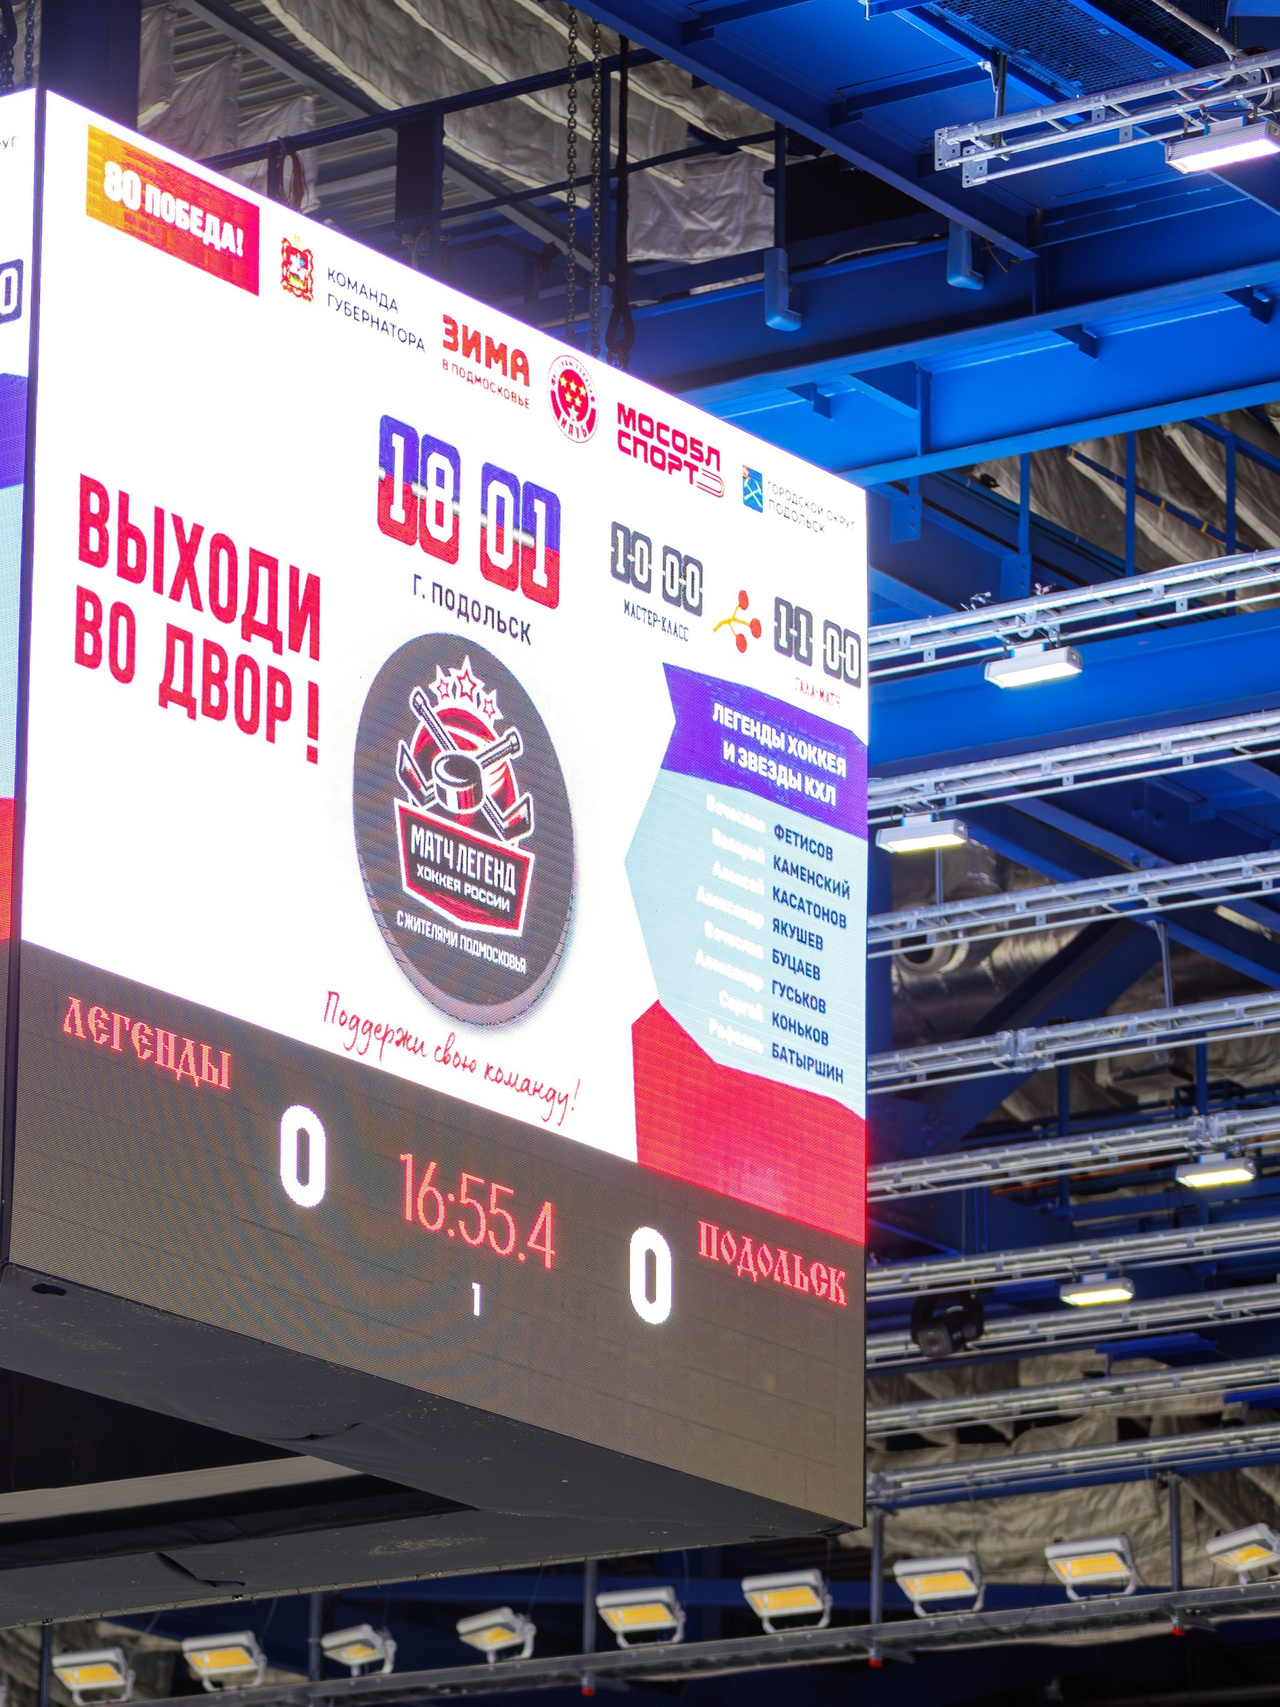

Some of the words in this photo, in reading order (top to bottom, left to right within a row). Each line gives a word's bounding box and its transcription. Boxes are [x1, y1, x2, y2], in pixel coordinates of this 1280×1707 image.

[104, 161, 142, 211] 80
[145, 184, 244, 257] ПОБЕДА!
[327, 266, 399, 313] КОМАНДА
[327, 293, 425, 353] ГУБЕРНАТОРА
[443, 314, 530, 387] ЗИМА
[442, 358, 449, 371] В
[452, 363, 529, 410] ПОДМОСКОВЬЕ
[617, 429, 699, 486] СПОРТ
[383, 424, 457, 554] 18
[483, 471, 554, 599] 01
[769, 498, 826, 536] ПОДОЛЬСК
[78, 473, 320, 662] ВЫХОДИ
[74, 584, 136, 684] ВО
[413, 573, 426, 599] Г.
[432, 581, 531, 645] ПОДОЛЬСК
[623, 599, 689, 642] МАСТЕР-КЛАСС
[713, 702, 785, 752] ЛЕГЕНДЫ
[788, 734, 847, 778] ХОККЕЯ
[723, 741, 735, 763] И
[738, 748, 802, 792] ЗВЕЗДЫ
[805, 775, 836, 807] КХЛ
[410, 824, 454, 870] МАТЧ
[456, 843, 516, 896] ЛЕГЕНД
[774, 823, 833, 861] ФЕТИСОВ
[416, 863, 461, 894] ХОККЕЯ
[464, 883, 510, 913] РОССИИ
[772, 885, 847, 929] КАСАТОНОВ
[773, 854, 850, 900] КАМЕНСКИЙ
[396, 910, 405, 927] С
[404, 912, 458, 948] ЖИТЕЛЯМИ
[459, 934, 527, 975] ПОДМОСКОВЬЯ
[772, 917, 824, 951] ЯКУШЕВ
[772, 948, 821, 981] БУЦАЕВ
[772, 979, 827, 1015] ГУСЬКОВ
[62, 996, 231, 1089] ЛЕГЕНДЫ
[324, 990, 427, 1062] Поддержи
[434, 1032, 477, 1073] свою
[483, 1062, 581, 1126] команду!
[772, 1011, 829, 1046] КОНЬКОВ
[772, 1042, 844, 1084] БАТЫРШИН
[279, 1104, 326, 1208] 0
[400, 1153, 556, 1270] 16:55.4
[629, 1226, 672, 1325] 0
[698, 1220, 847, 1306] ПОДОЛЬСК
[471, 1282, 480, 1316] 1
